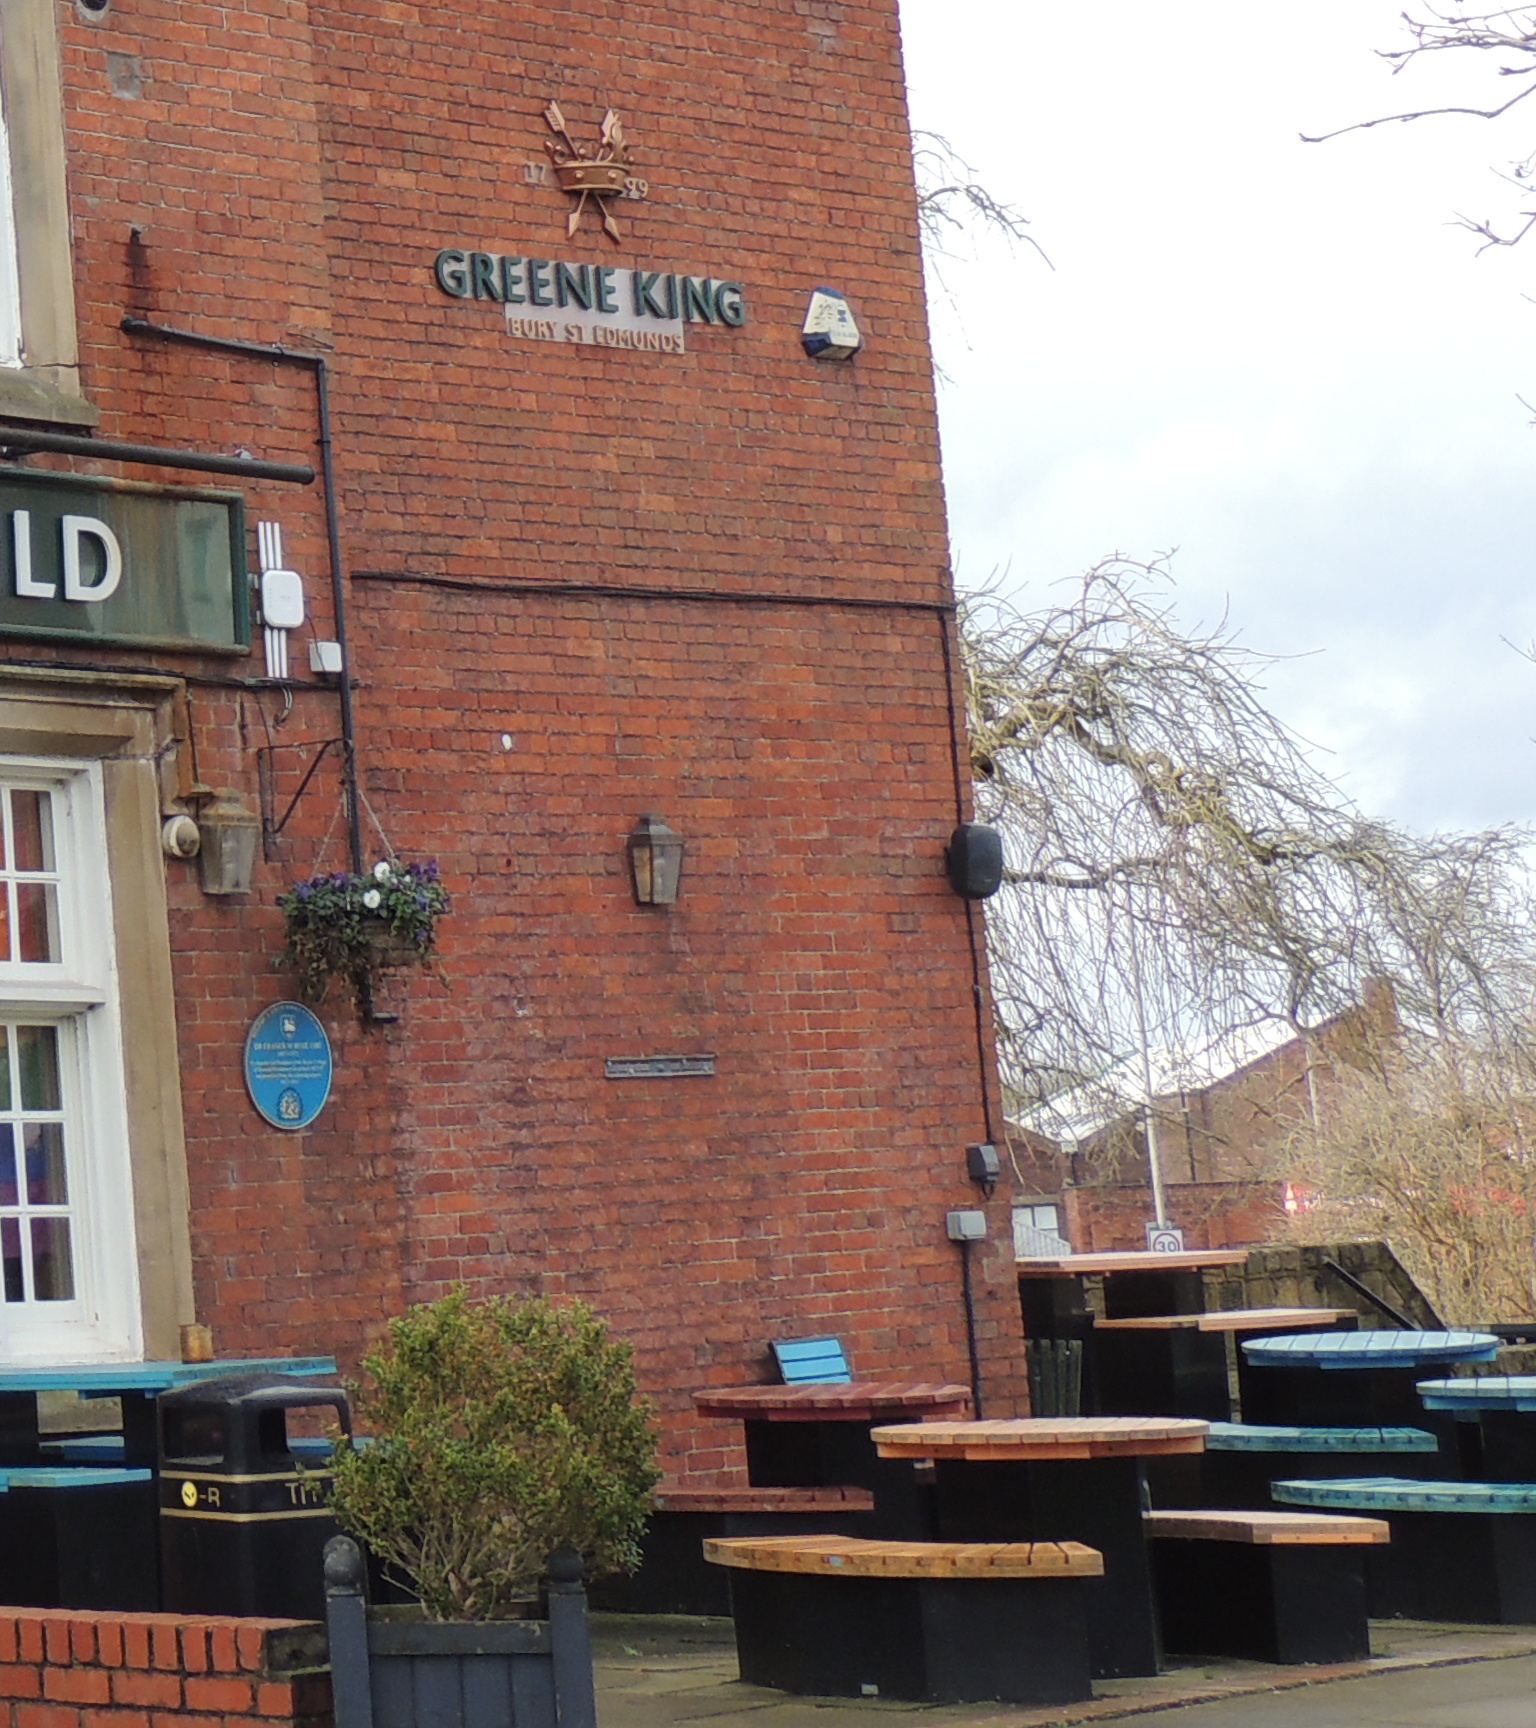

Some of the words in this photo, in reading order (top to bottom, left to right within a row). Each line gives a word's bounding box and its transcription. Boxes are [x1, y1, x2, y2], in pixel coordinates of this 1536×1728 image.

[434, 249, 620, 313] GREENE
[633, 270, 747, 327] KING
[508, 317, 557, 339] BURY
[565, 322, 588, 342] ST
[593, 325, 684, 352] EDMUNDS
[1157, 1241, 1177, 1252] 30
